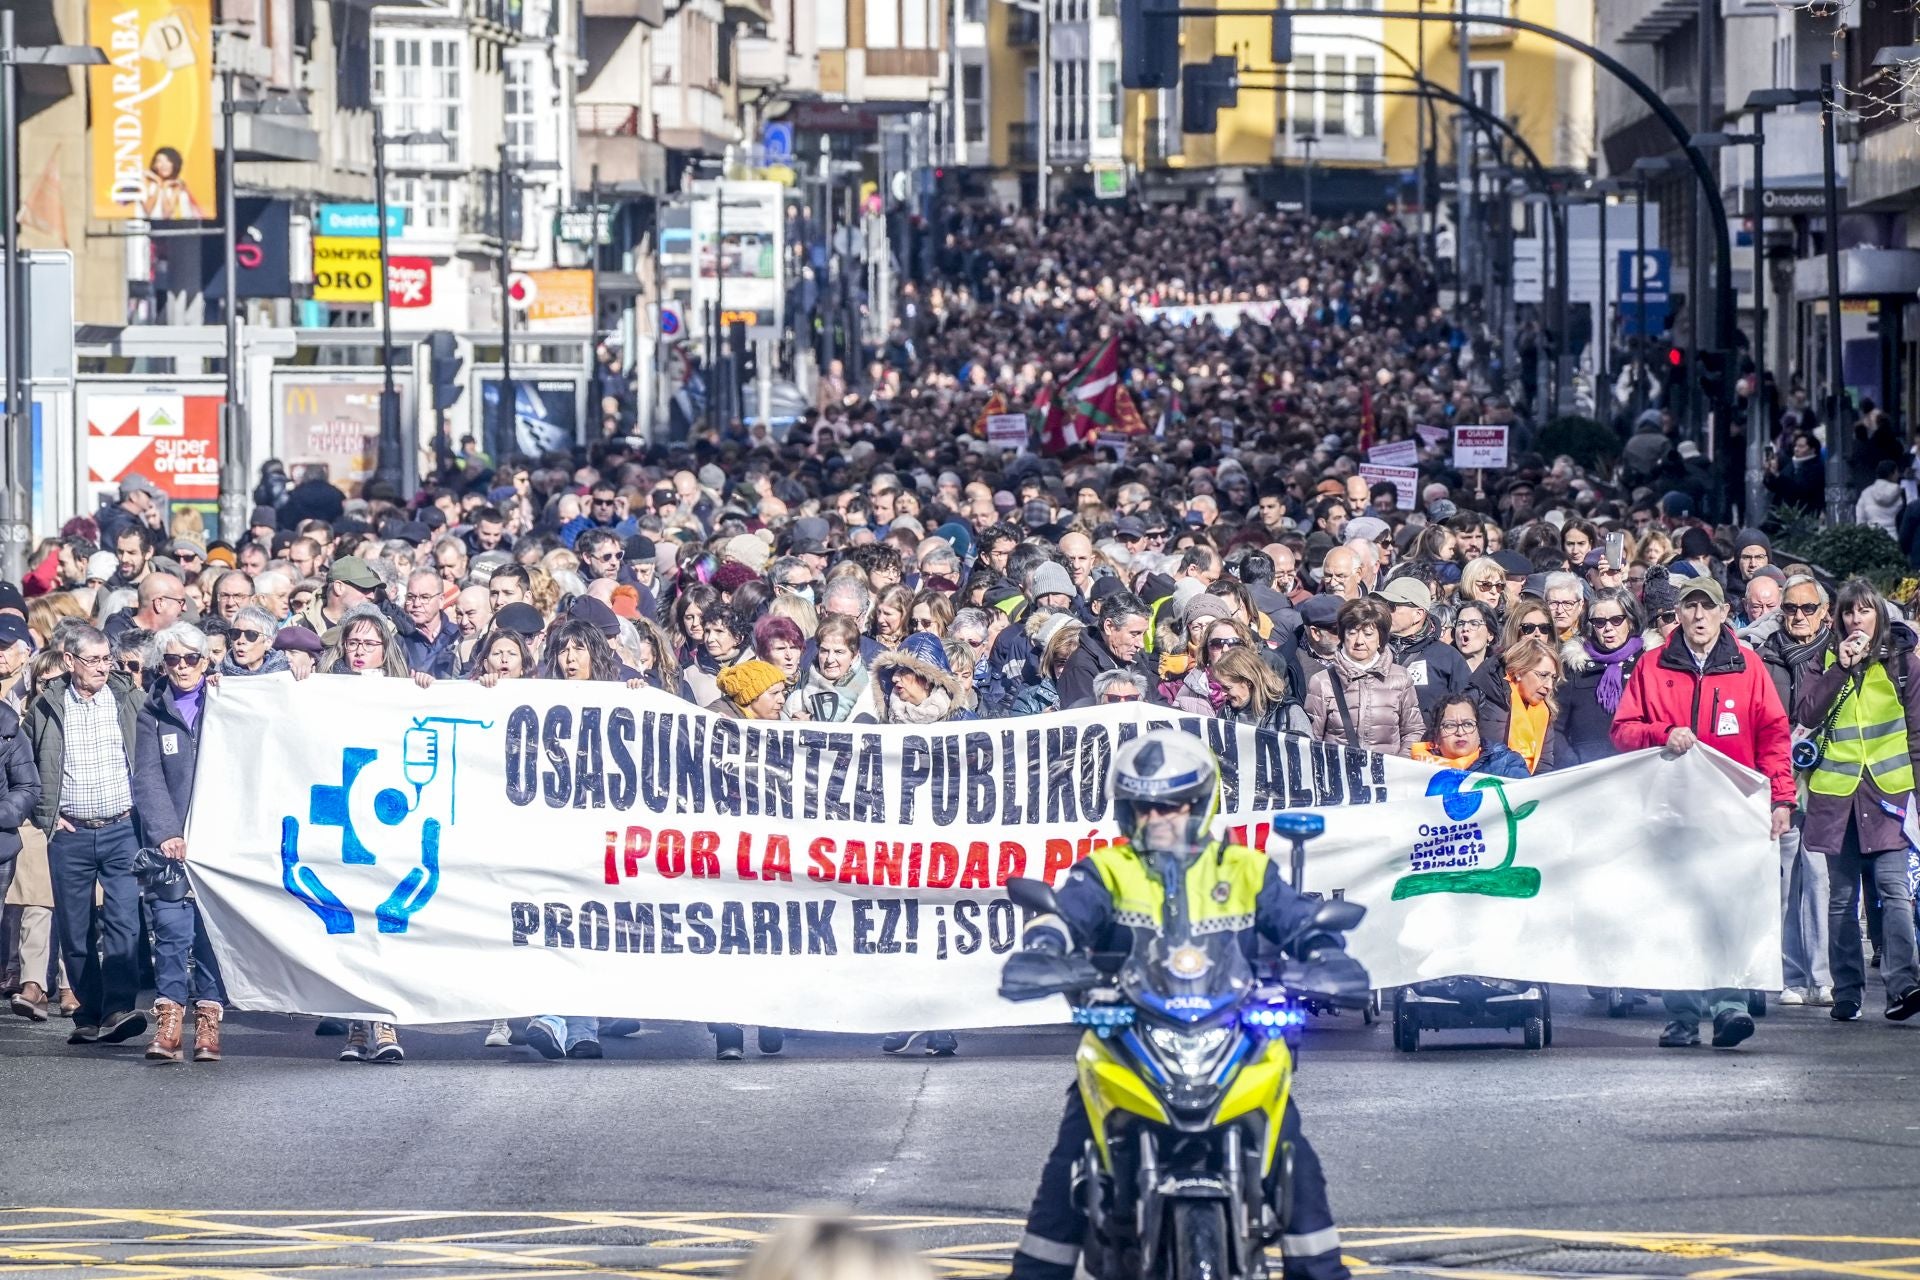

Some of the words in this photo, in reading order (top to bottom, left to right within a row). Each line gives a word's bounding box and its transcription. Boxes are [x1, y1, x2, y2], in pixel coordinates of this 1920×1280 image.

[111, 8, 147, 203] DENDARABA
[316, 271, 372, 288] ORO
[154, 439, 209, 460] super
[153, 456, 218, 473] oferta
[505, 704, 886, 824] OSASUNGINTZA
[1252, 727, 1388, 812] ALDE!
[1413, 829, 1483, 852] publikoa
[1418, 822, 1478, 837] Osasun
[604, 825, 721, 885] ¡POR
[736, 831, 793, 883] LA
[807, 836, 1027, 889] SANIDAD
[1458, 841, 1486, 856] eta
[511, 900, 838, 956] PROMESARIK
[852, 899, 919, 955] EZ!
